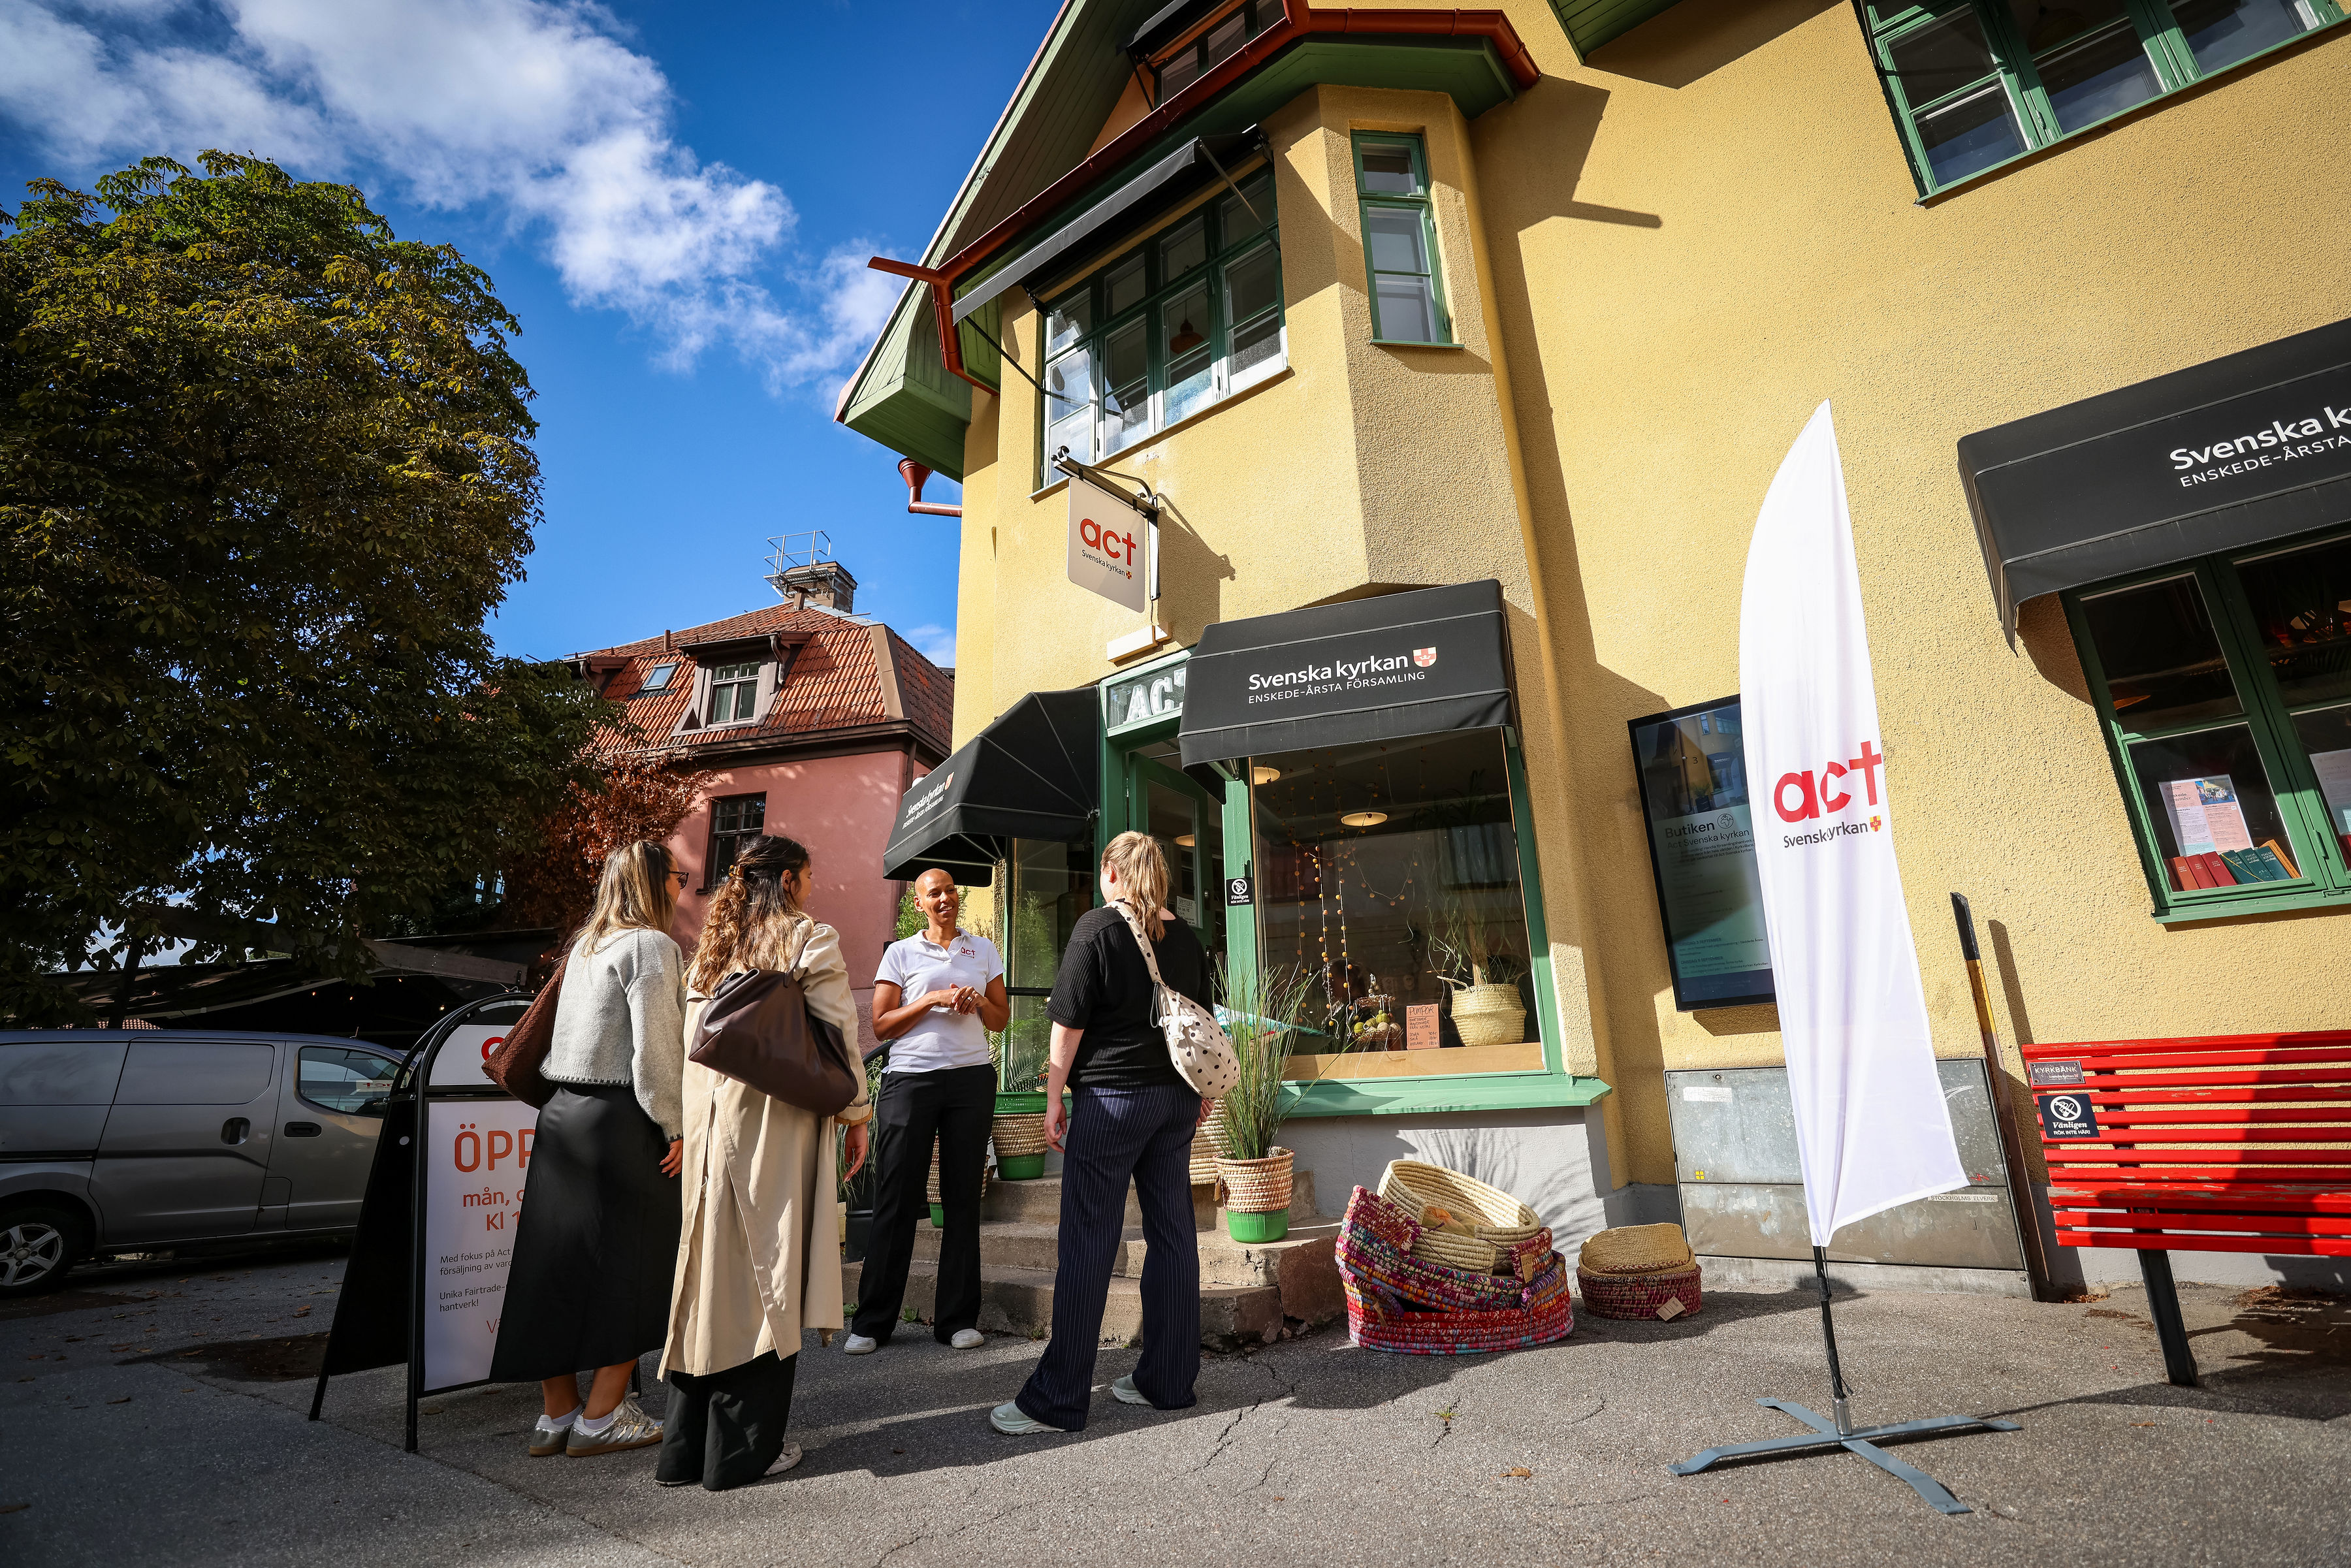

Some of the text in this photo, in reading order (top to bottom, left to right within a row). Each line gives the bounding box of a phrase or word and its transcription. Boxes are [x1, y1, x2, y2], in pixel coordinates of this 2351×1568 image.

[2169, 406, 2351, 470] Svenska k
[2180, 435, 2351, 487] ENSKEDE-ÅRSTA
[1080, 518, 1136, 566] act
[1081, 549, 1125, 576] Svenska kyrkan
[1248, 655, 1408, 690] Svenska kyrkan
[1248, 671, 1425, 704] ENSKEDE-ÅRSTA FÖRSAMLING
[1774, 741, 1882, 823] act
[1665, 822, 1715, 839] Butiken
[1684, 834, 1719, 846] Svenska
[1720, 829, 1750, 841] kyrkan
[961, 946, 976, 956] act
[1409, 1006, 1434, 1016] PUMPOR
[2052, 1121, 2087, 1130] Vänligen
[454, 1123, 536, 1173] ÖPP
[463, 1187, 510, 1208] mån,
[440, 1248, 511, 1264] Med fokus på Act
[440, 1264, 482, 1275] försäljning
[440, 1290, 462, 1300] Unika
[440, 1298, 479, 1312] hantverk!
